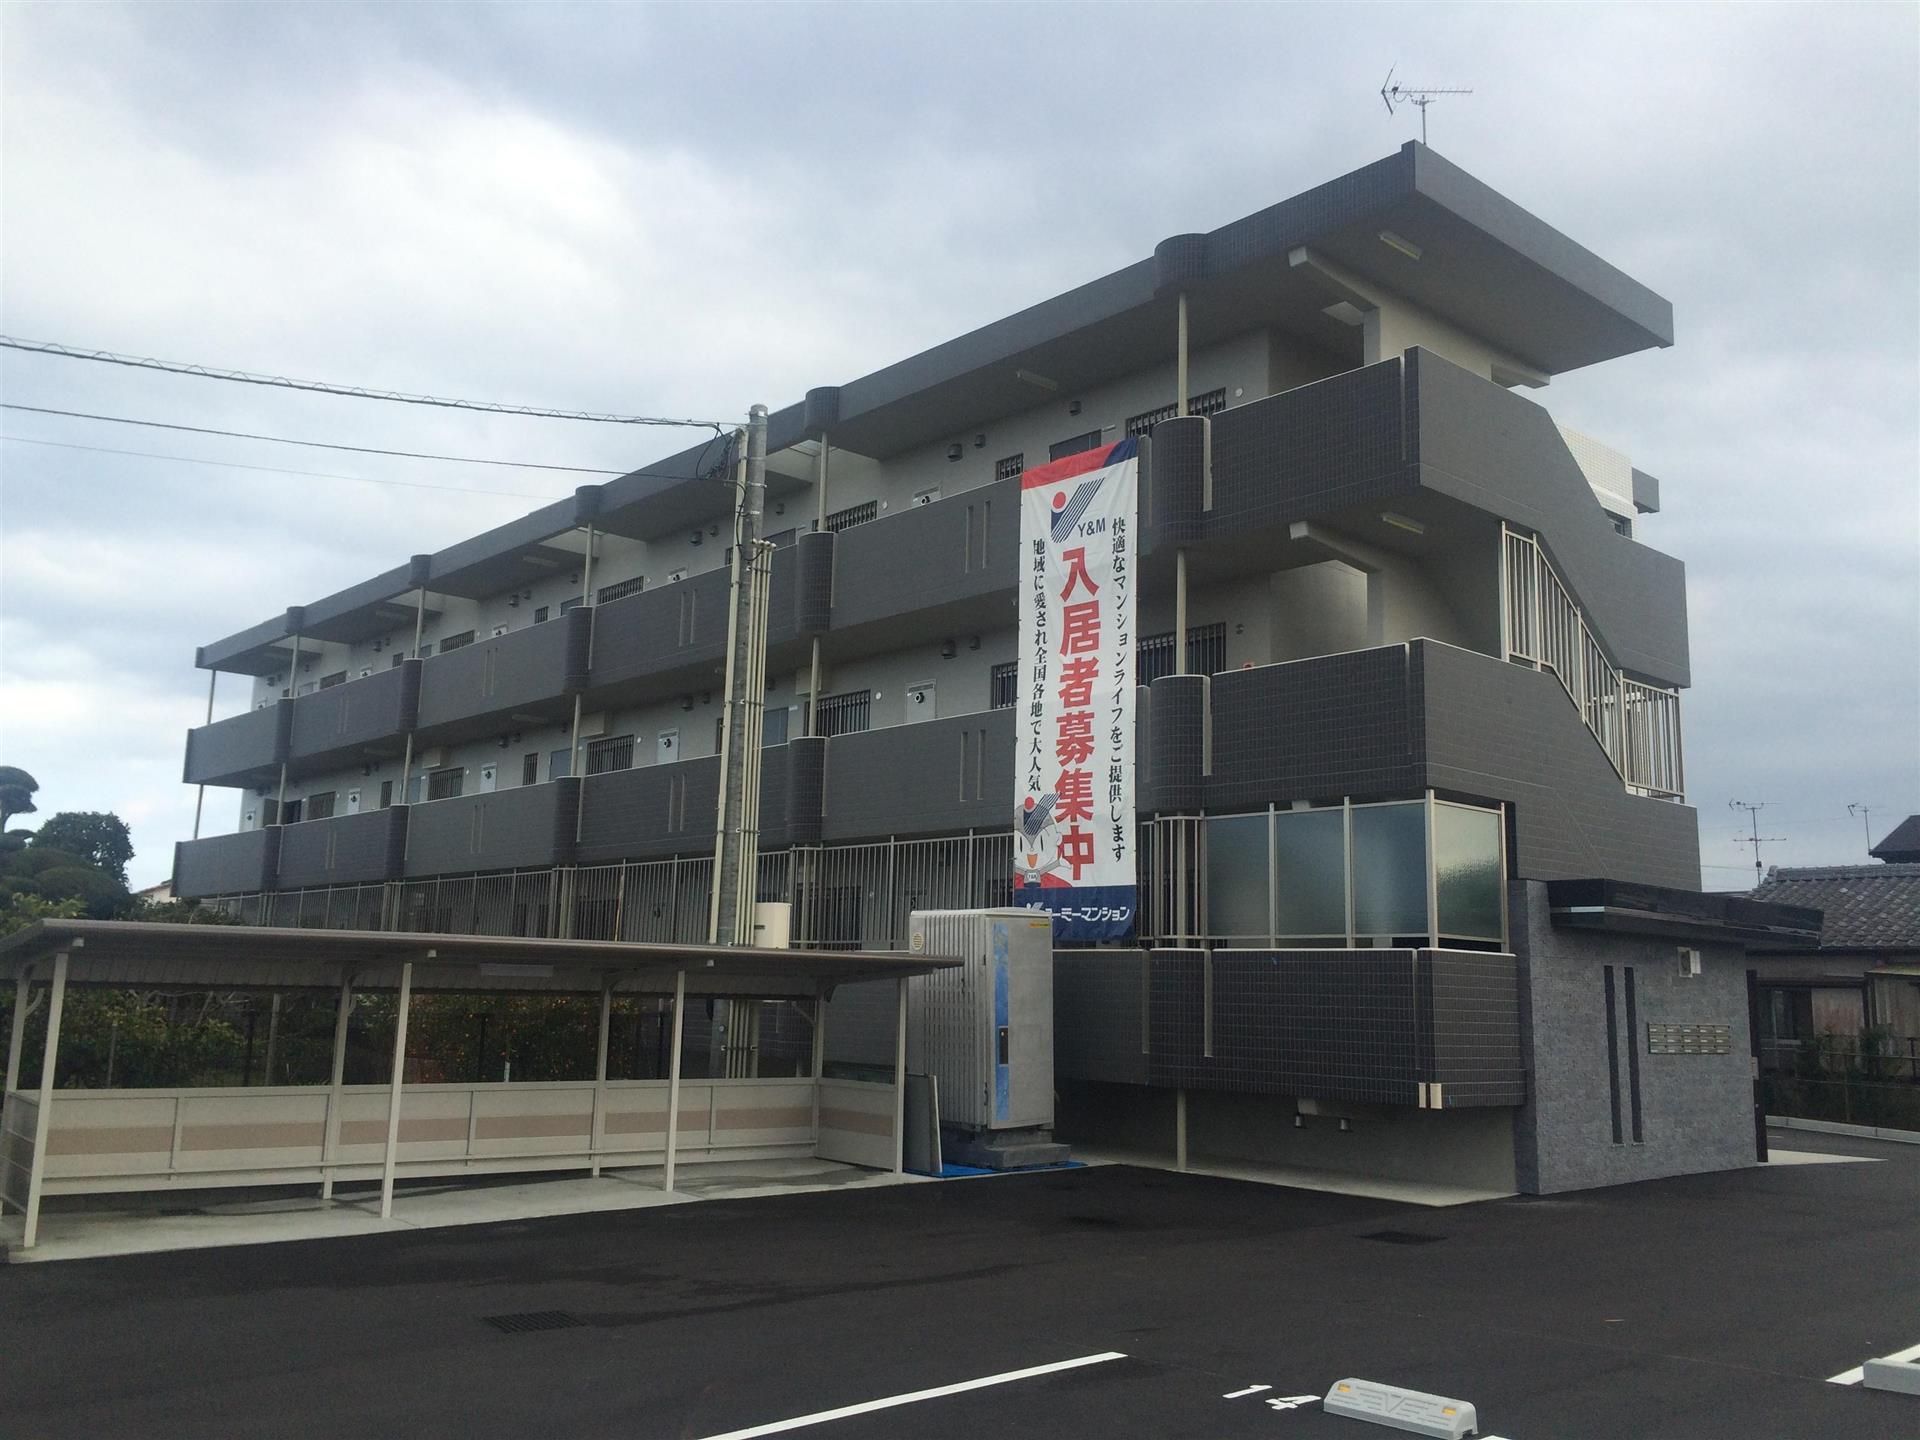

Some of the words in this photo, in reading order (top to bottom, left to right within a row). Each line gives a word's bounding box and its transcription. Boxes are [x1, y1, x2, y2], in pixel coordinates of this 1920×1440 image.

[1027, 538, 1048, 792] 地域に愛され全国各地で大人気
[1077, 517, 1106, 538] Y&M
[1054, 546, 1102, 881] 入居者募集中
[1108, 517, 1129, 863] 快適なマンションライフをご提供します
